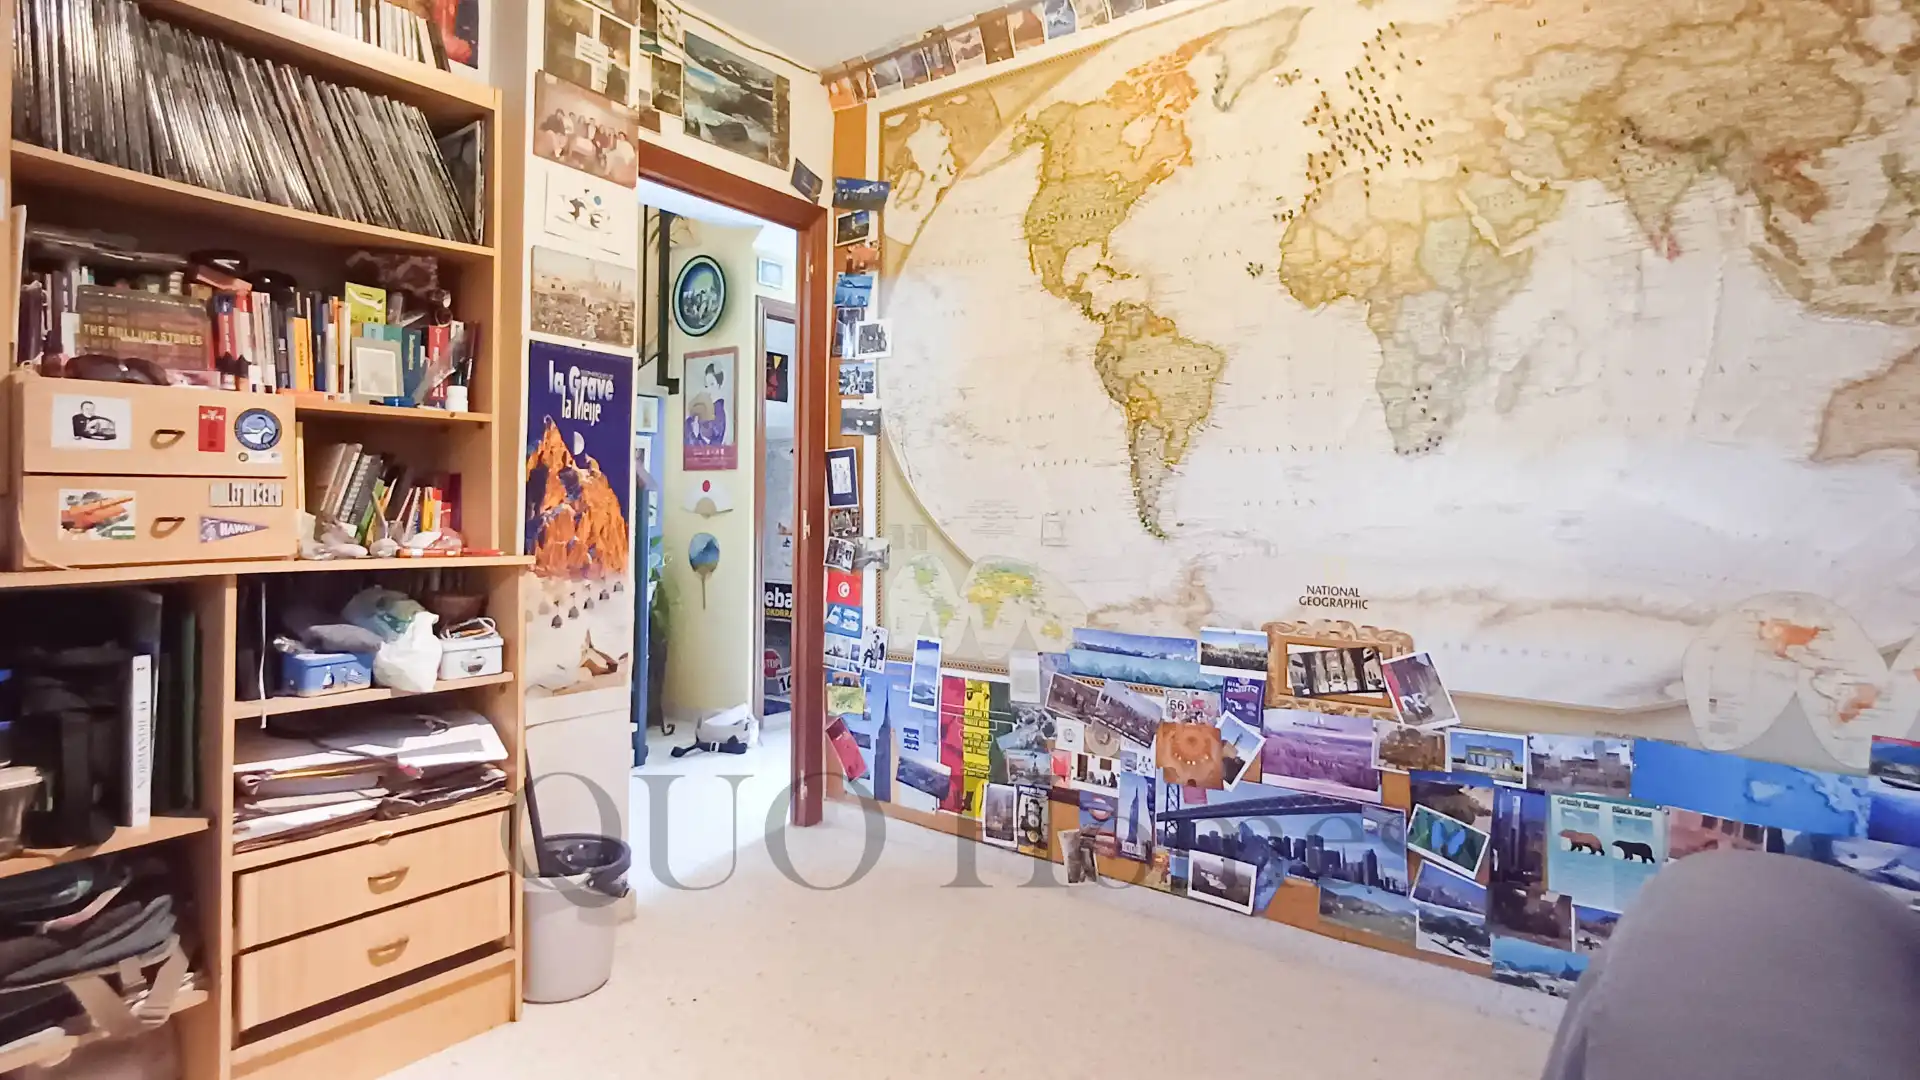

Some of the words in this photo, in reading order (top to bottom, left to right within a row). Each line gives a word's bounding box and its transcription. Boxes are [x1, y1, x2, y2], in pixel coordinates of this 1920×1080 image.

[83, 324, 105, 337] THE
[107, 326, 158, 343] ROLLING
[159, 331, 204, 346] STONES
[548, 360, 565, 395] la
[569, 366, 614, 401] Grave
[562, 385, 572, 419] la
[1306, 585, 1361, 598] NATIONAL
[1298, 595, 1369, 610] GEOGRAPHIC
[1169, 699, 1186, 711] 66
